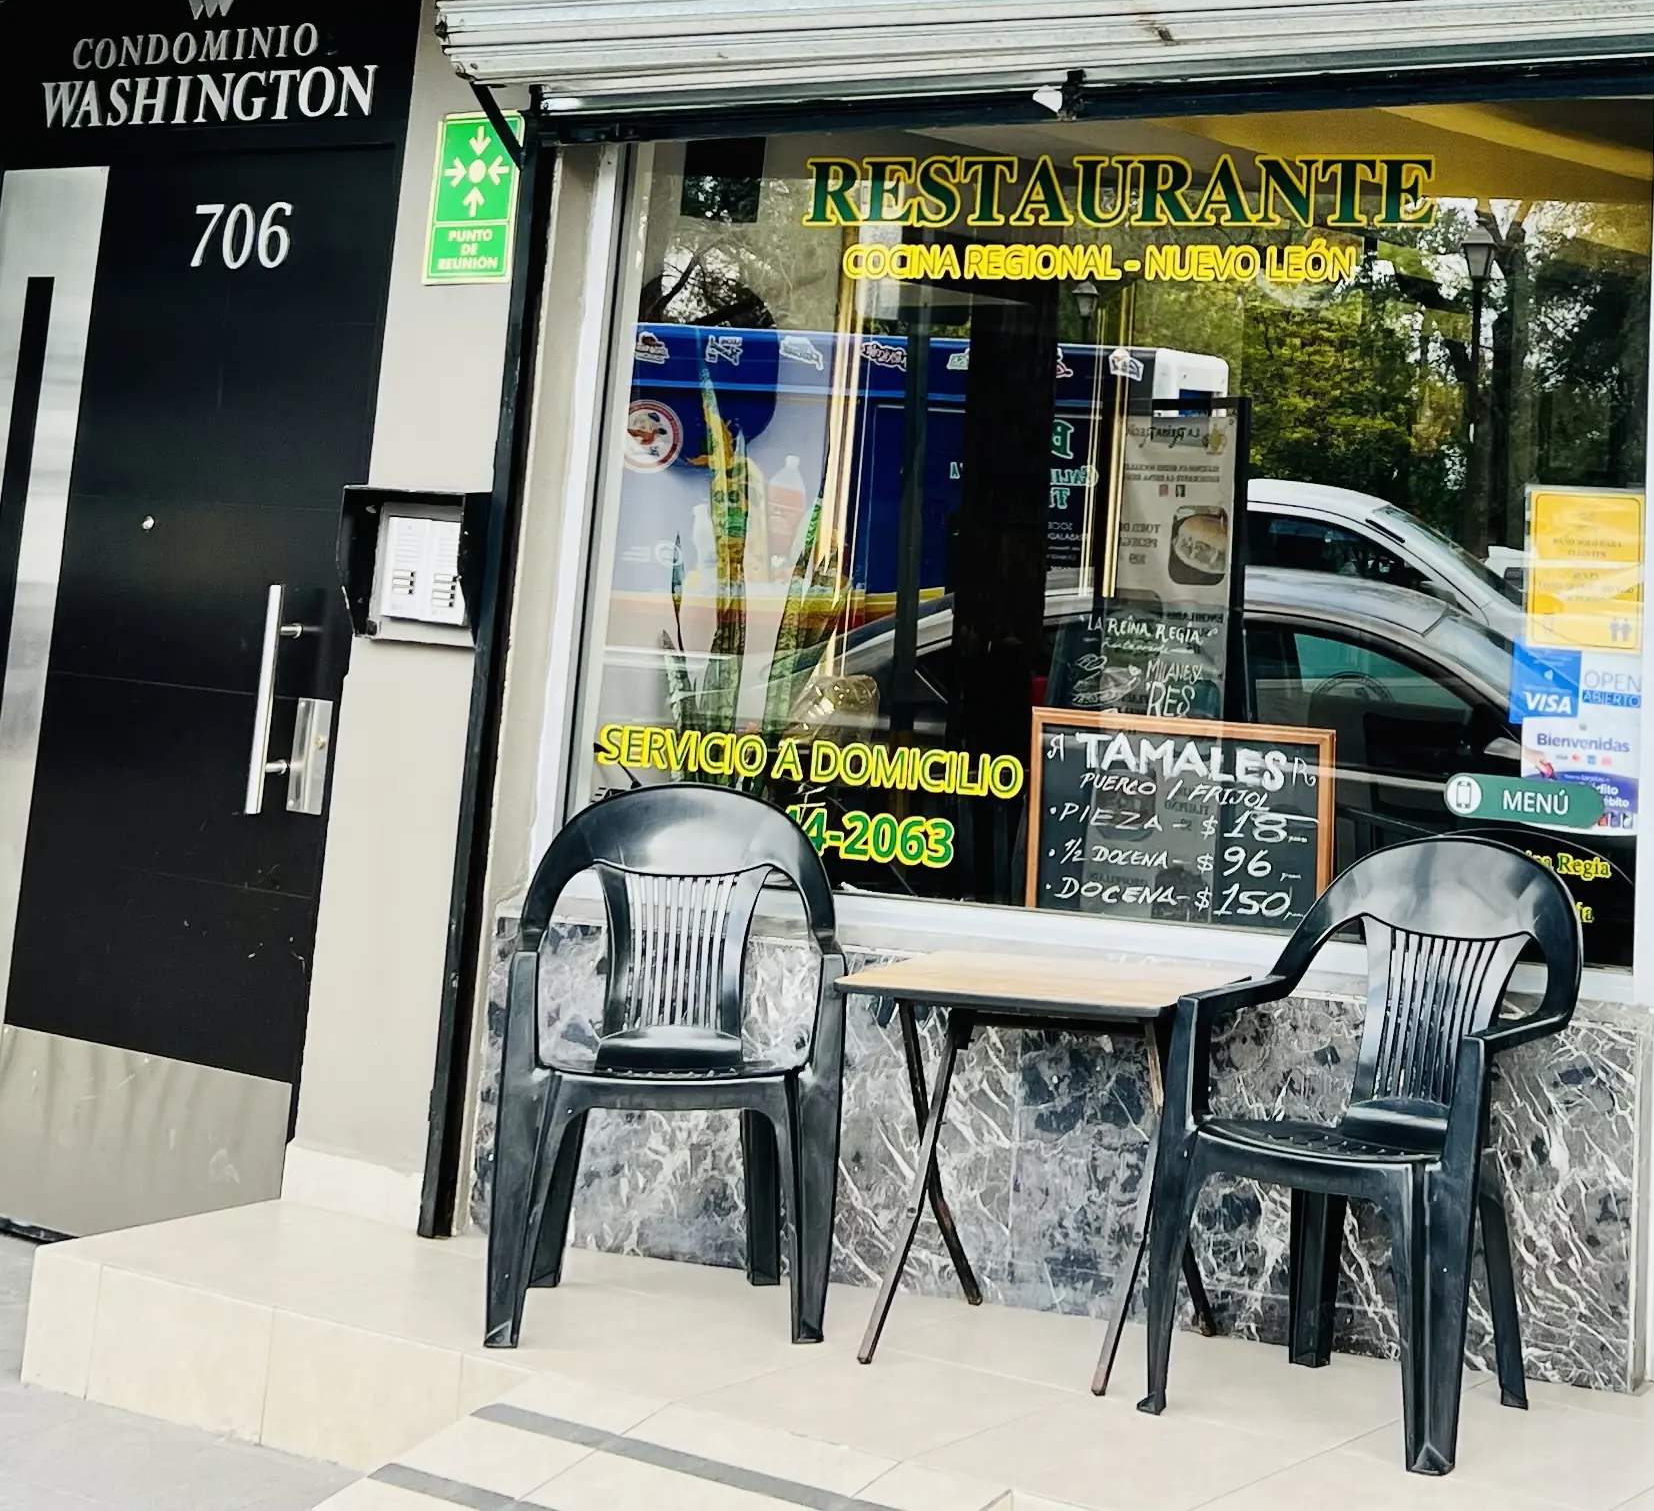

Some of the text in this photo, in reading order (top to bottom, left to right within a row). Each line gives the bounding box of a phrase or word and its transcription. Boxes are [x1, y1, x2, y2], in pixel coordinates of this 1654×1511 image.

[73, 23, 319, 69] CONDOMINIO
[42, 65, 378, 128] WASHINGTON
[803, 154, 1435, 229] RESTAURANTE
[190, 202, 293, 269] 706
[448, 228, 493, 242] PUNTO
[460, 243, 478, 256] DE
[437, 255, 498, 270] REUNIÓN
[843, 244, 961, 281] COCINA
[963, 246, 1124, 280] REGIONAL
[1144, 246, 1260, 282] NUEVO
[1265, 238, 1358, 283] LEÓN
[1584, 670, 1641, 693] OPEN
[1523, 692, 1572, 715] VISA
[1583, 691, 1641, 708] ABIERTO
[597, 724, 1024, 799] SERVICIO A DOMICILIO
[1075, 731, 1288, 791] TAMALES
[1080, 772, 1157, 796] PUERCO
[1188, 784, 1271, 812] FRIJOL
[1503, 789, 1569, 816] MENÚ
[1059, 802, 1163, 832] PIEZA
[1091, 844, 1169, 870] DOCENA
[1556, 852, 1613, 882] Regia
[1054, 875, 1178, 906] DOCENA
